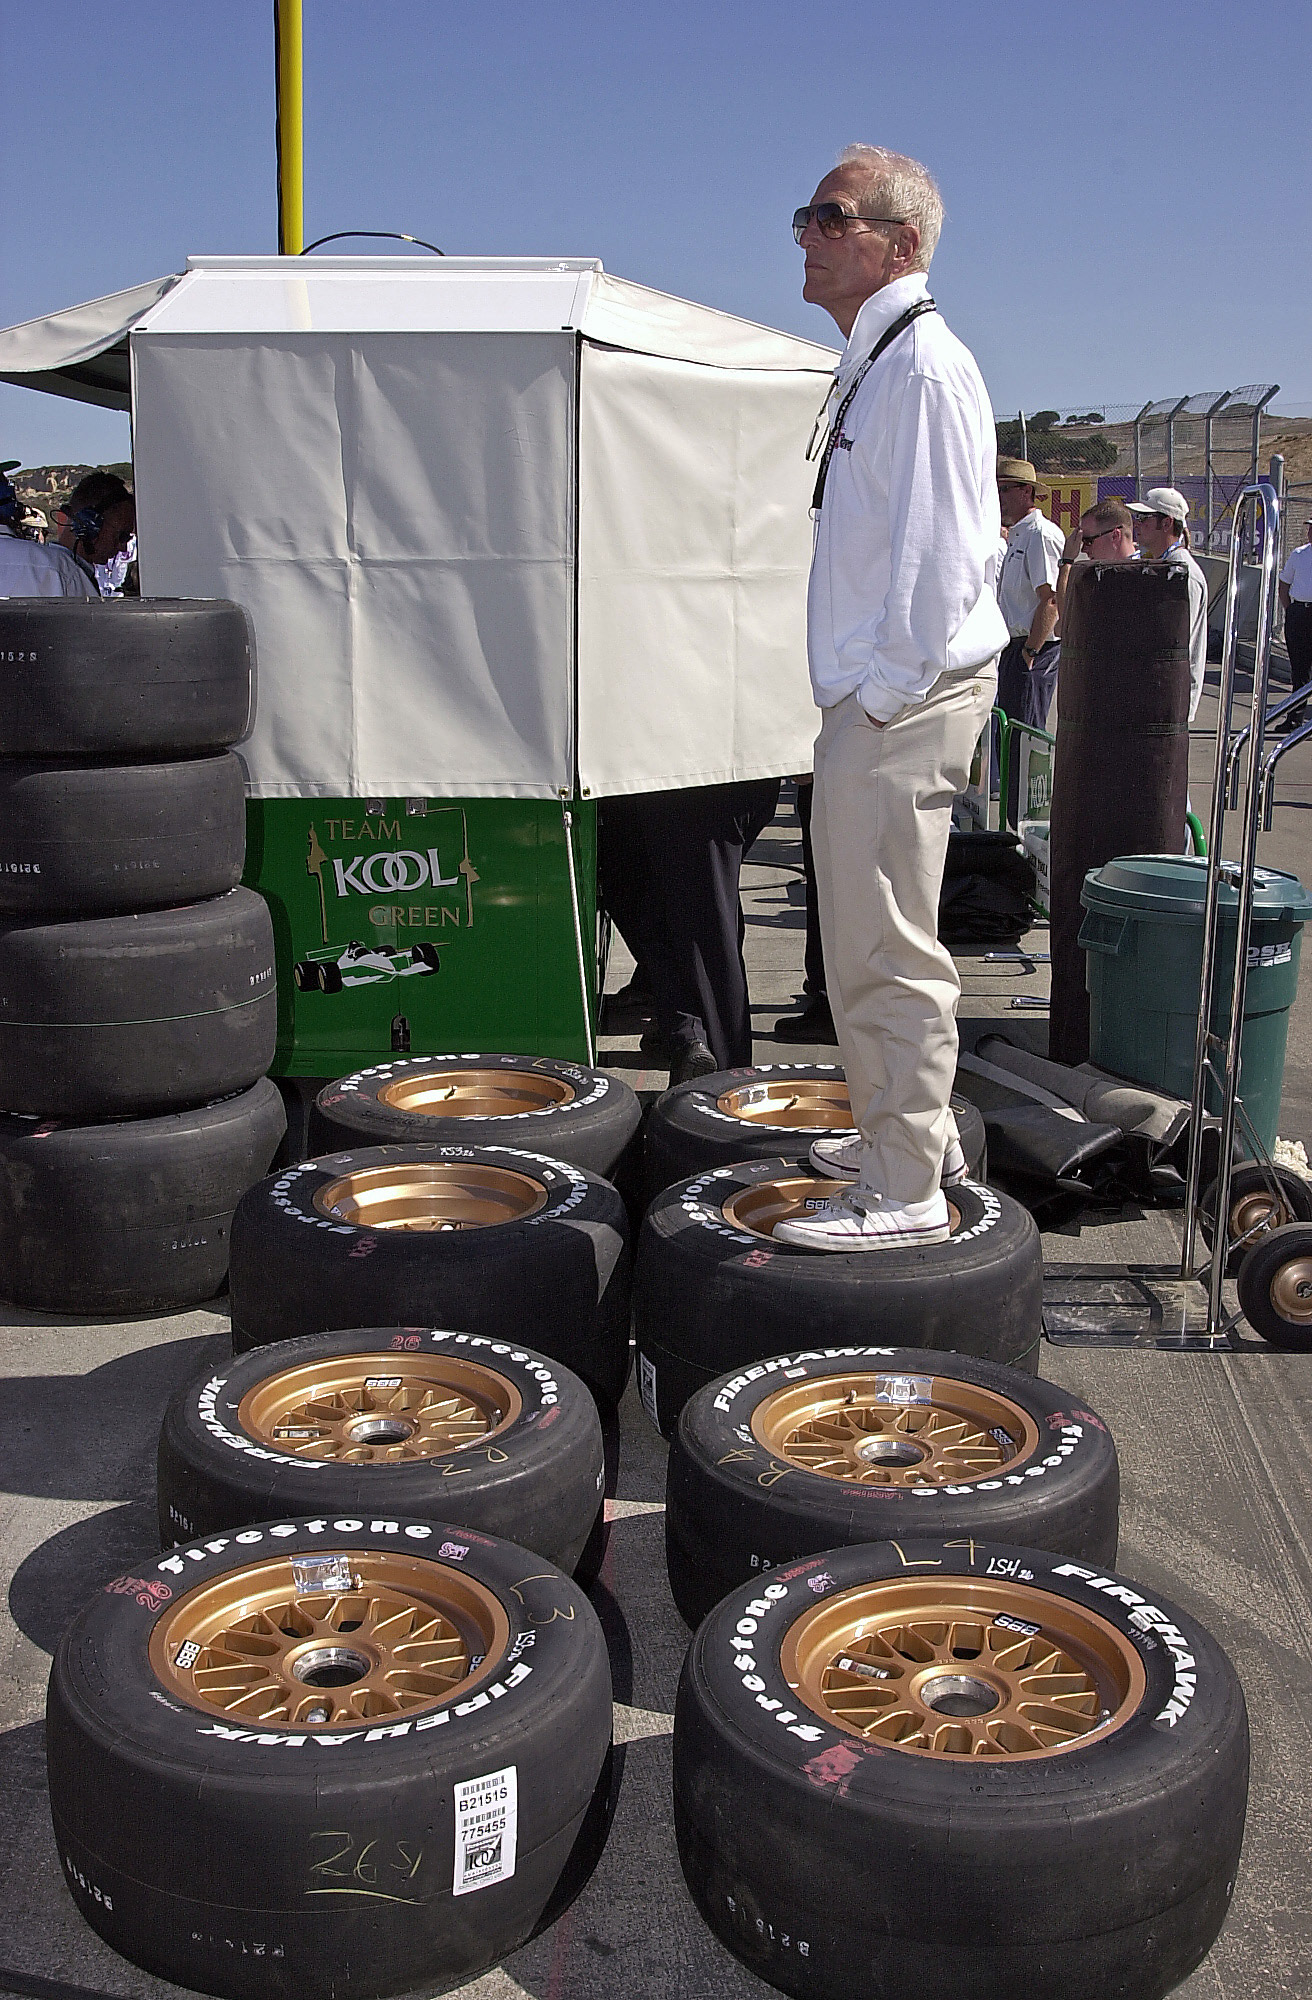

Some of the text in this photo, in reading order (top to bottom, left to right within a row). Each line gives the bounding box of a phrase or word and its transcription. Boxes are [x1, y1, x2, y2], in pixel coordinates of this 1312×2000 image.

[324, 819, 402, 841] TEAM
[332, 847, 458, 897] KOOL
[368, 905, 460, 927] GREEN
[339, 1053, 481, 1092] Firestone
[268, 1162, 357, 1234] Firestone
[474, 1145, 589, 1220] FIREHAWK
[680, 1168, 758, 1244] Firestone
[430, 1330, 559, 1405] Firestone
[714, 1347, 900, 1413] FIREHAWK
[198, 1375, 330, 1470] FIREHAWK
[910, 1424, 1103, 1498] Firestone
[157, 1519, 433, 1575] Firestone
[891, 1538, 986, 1566] L 4
[173, 1640, 201, 1669] BBS
[994, 1614, 1043, 1637] BBS
[1051, 1563, 1197, 1728] FIREHAWK
[730, 1583, 827, 1743] Firestone
[196, 1661, 534, 1747] FIREHAWK
[460, 1787, 508, 1812] B2151S
[461, 1818, 506, 1842] 775455
